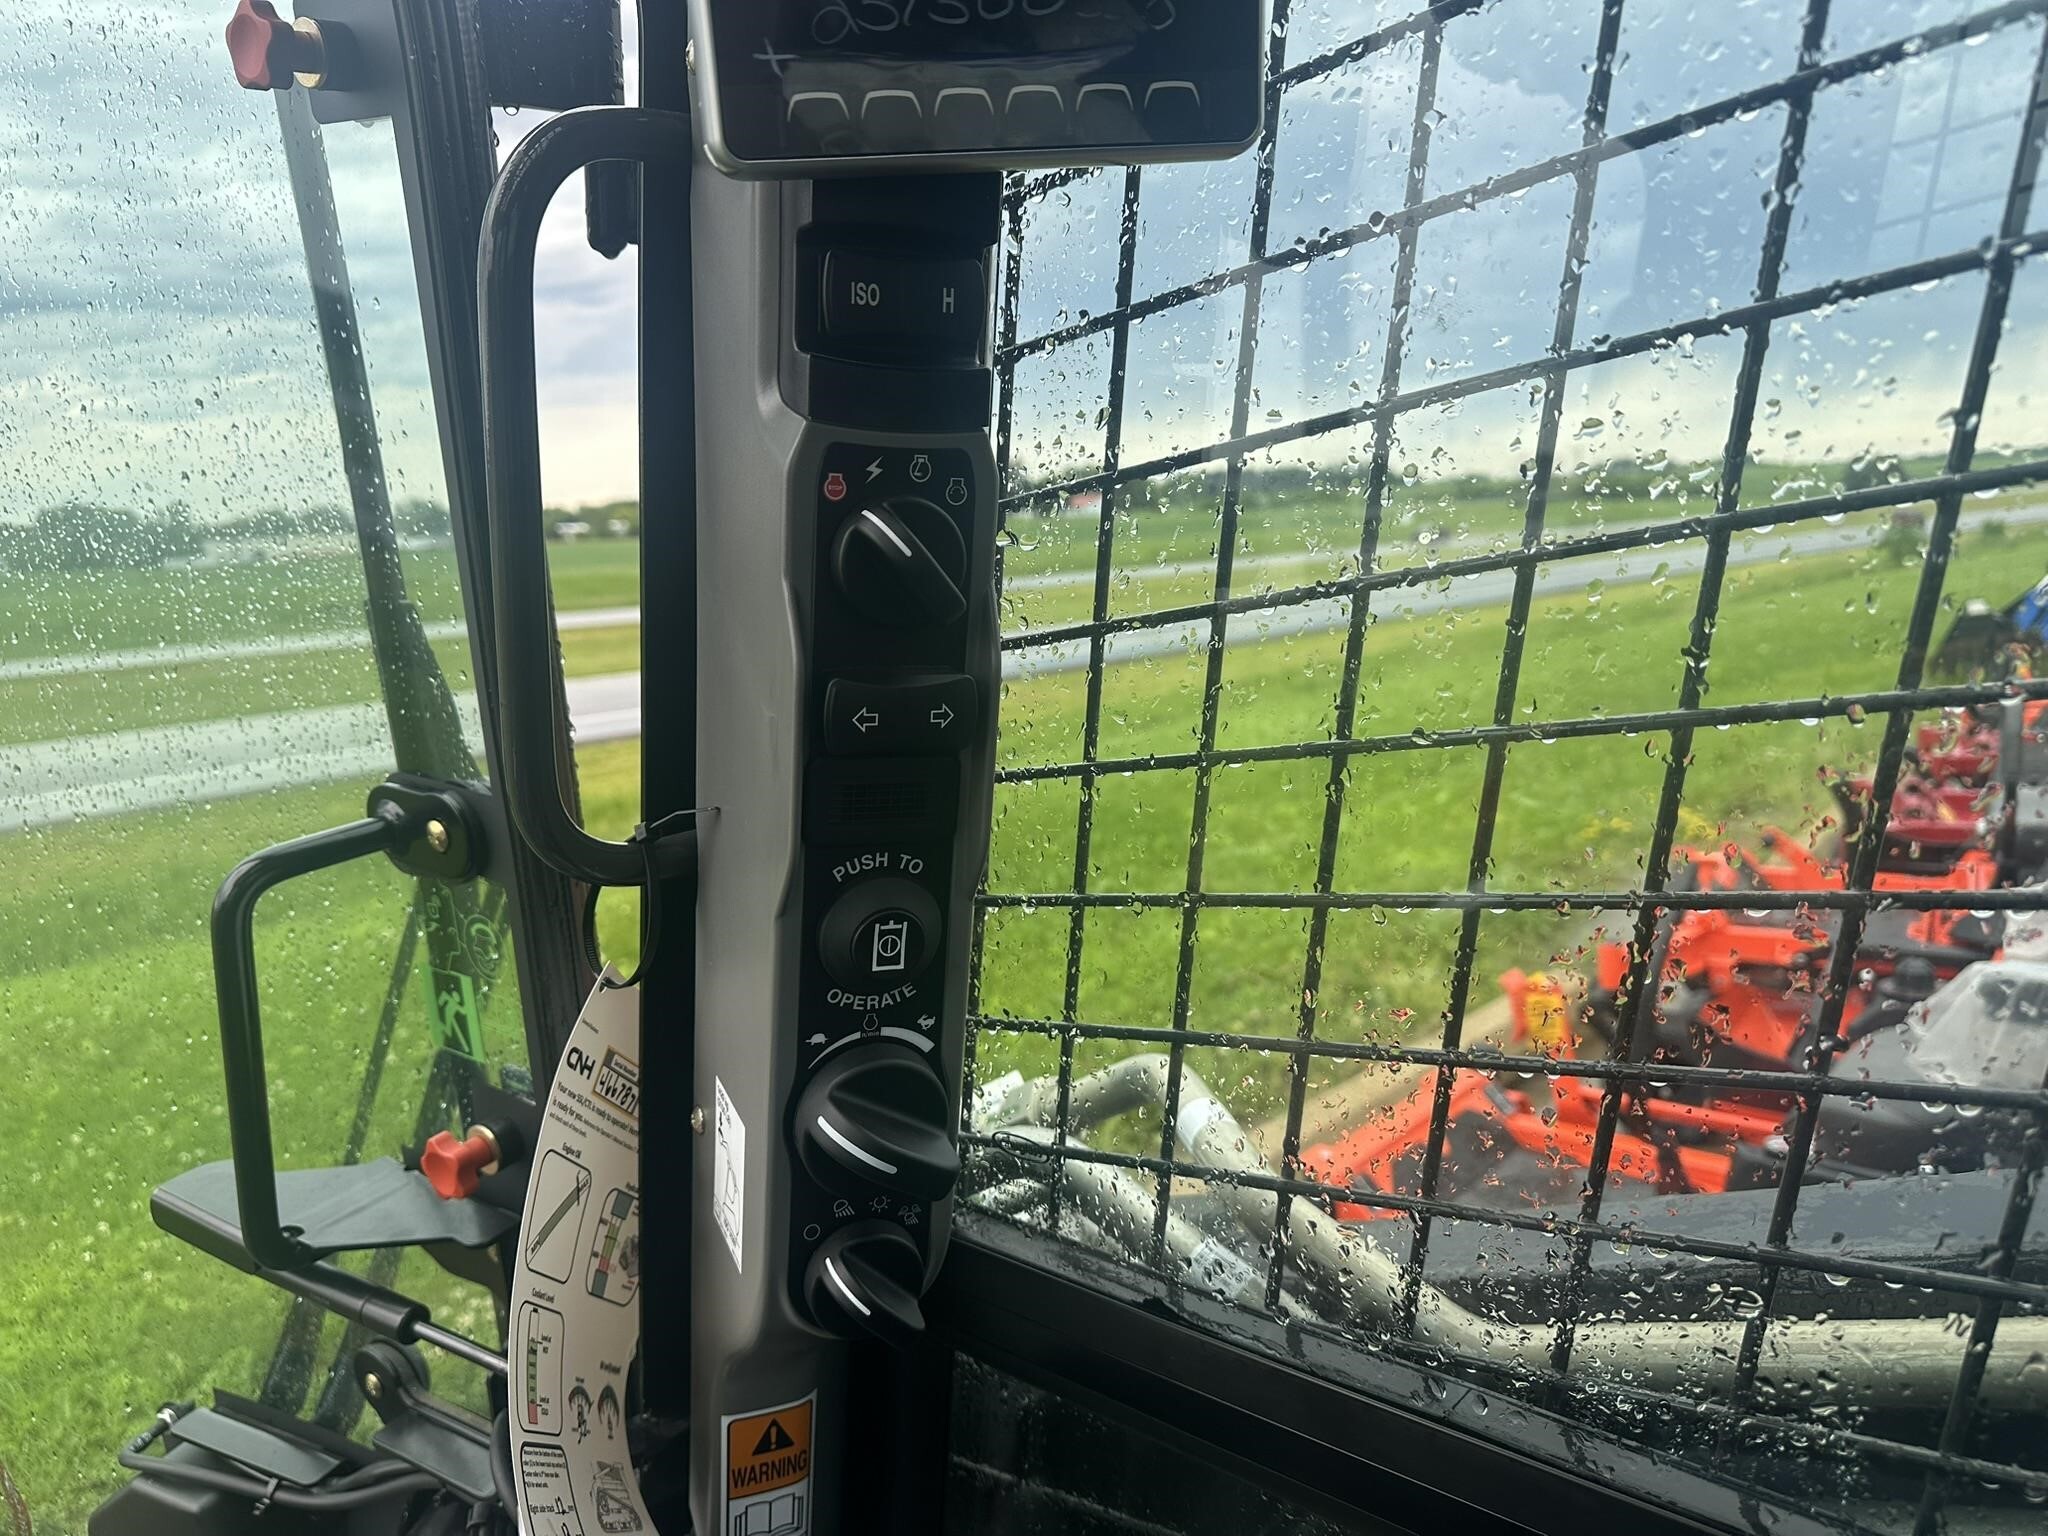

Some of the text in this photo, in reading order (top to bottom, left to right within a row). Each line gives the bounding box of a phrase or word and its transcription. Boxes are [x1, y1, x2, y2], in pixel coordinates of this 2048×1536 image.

[850, 281, 880, 307] ISO
[942, 287, 954, 314] H
[832, 852, 924, 883] PUSH TO
[826, 981, 917, 1011] OPERATE
[567, 1046, 596, 1080] CNH
[732, 1449, 807, 1489] WARNING
